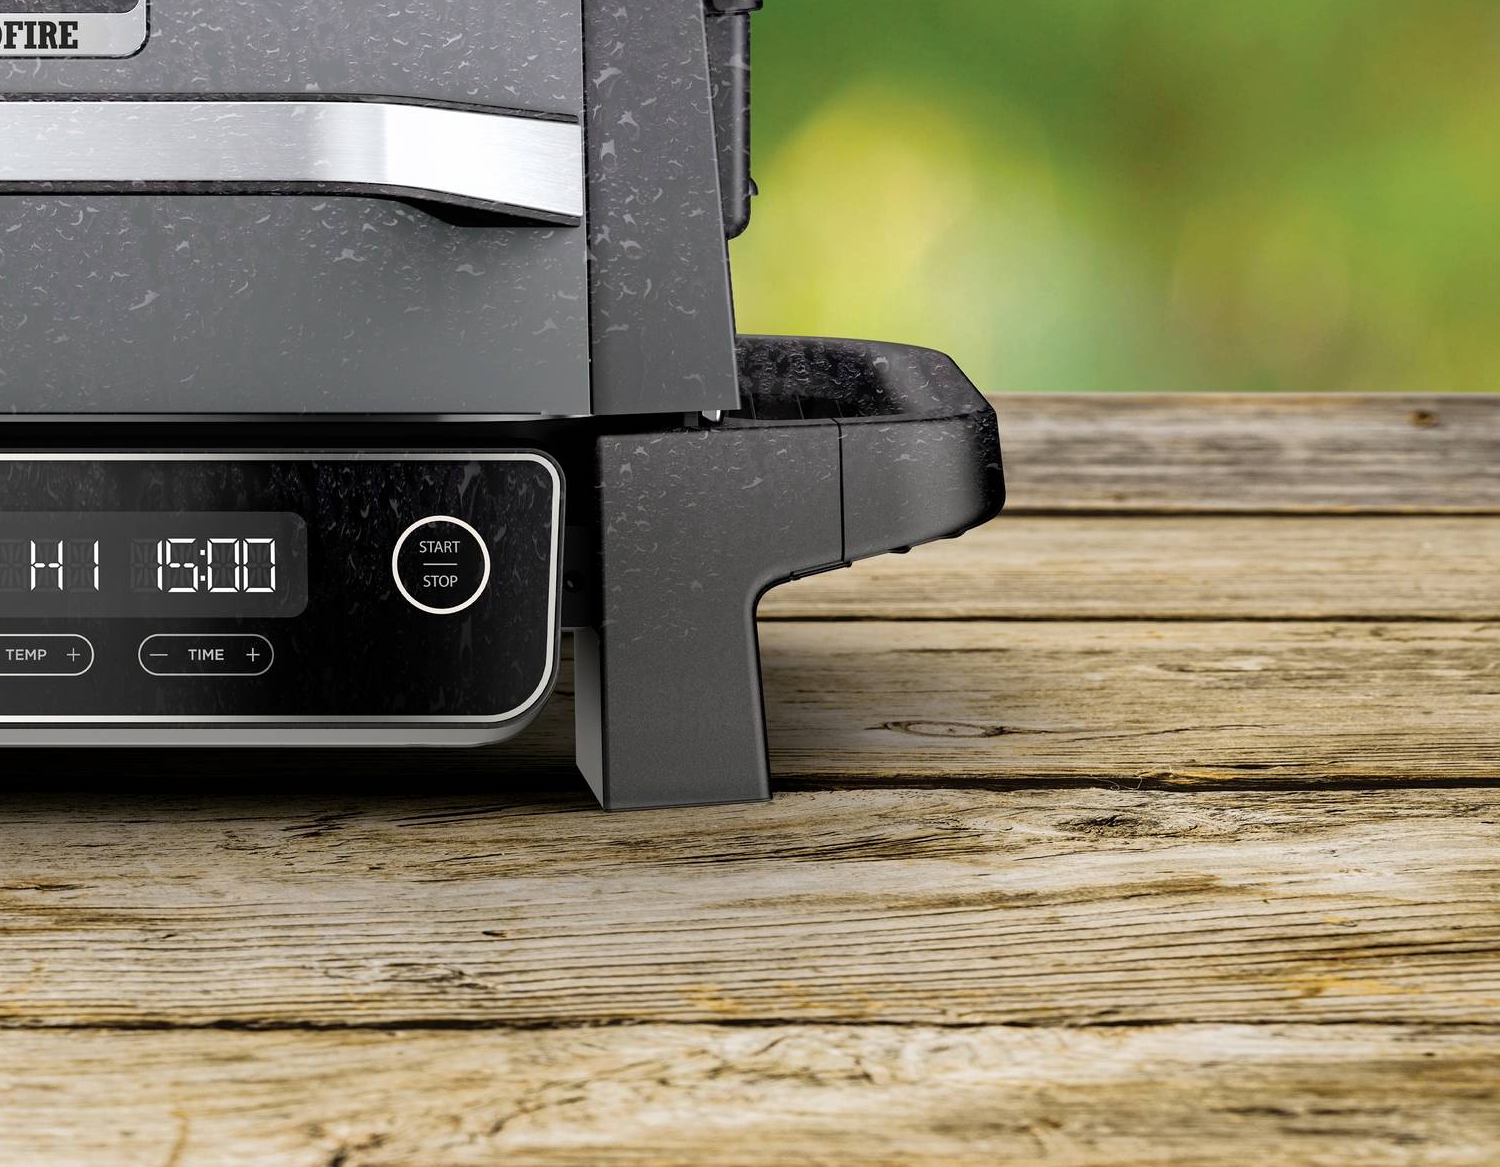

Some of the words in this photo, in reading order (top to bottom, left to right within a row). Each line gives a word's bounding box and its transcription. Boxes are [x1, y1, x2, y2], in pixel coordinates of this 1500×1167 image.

[419, 540, 461, 555] START
[157, 538, 276, 593] 15:00
[423, 574, 458, 589] STOP
[6, 648, 47, 661] TEMP
[188, 648, 224, 661] TIME
